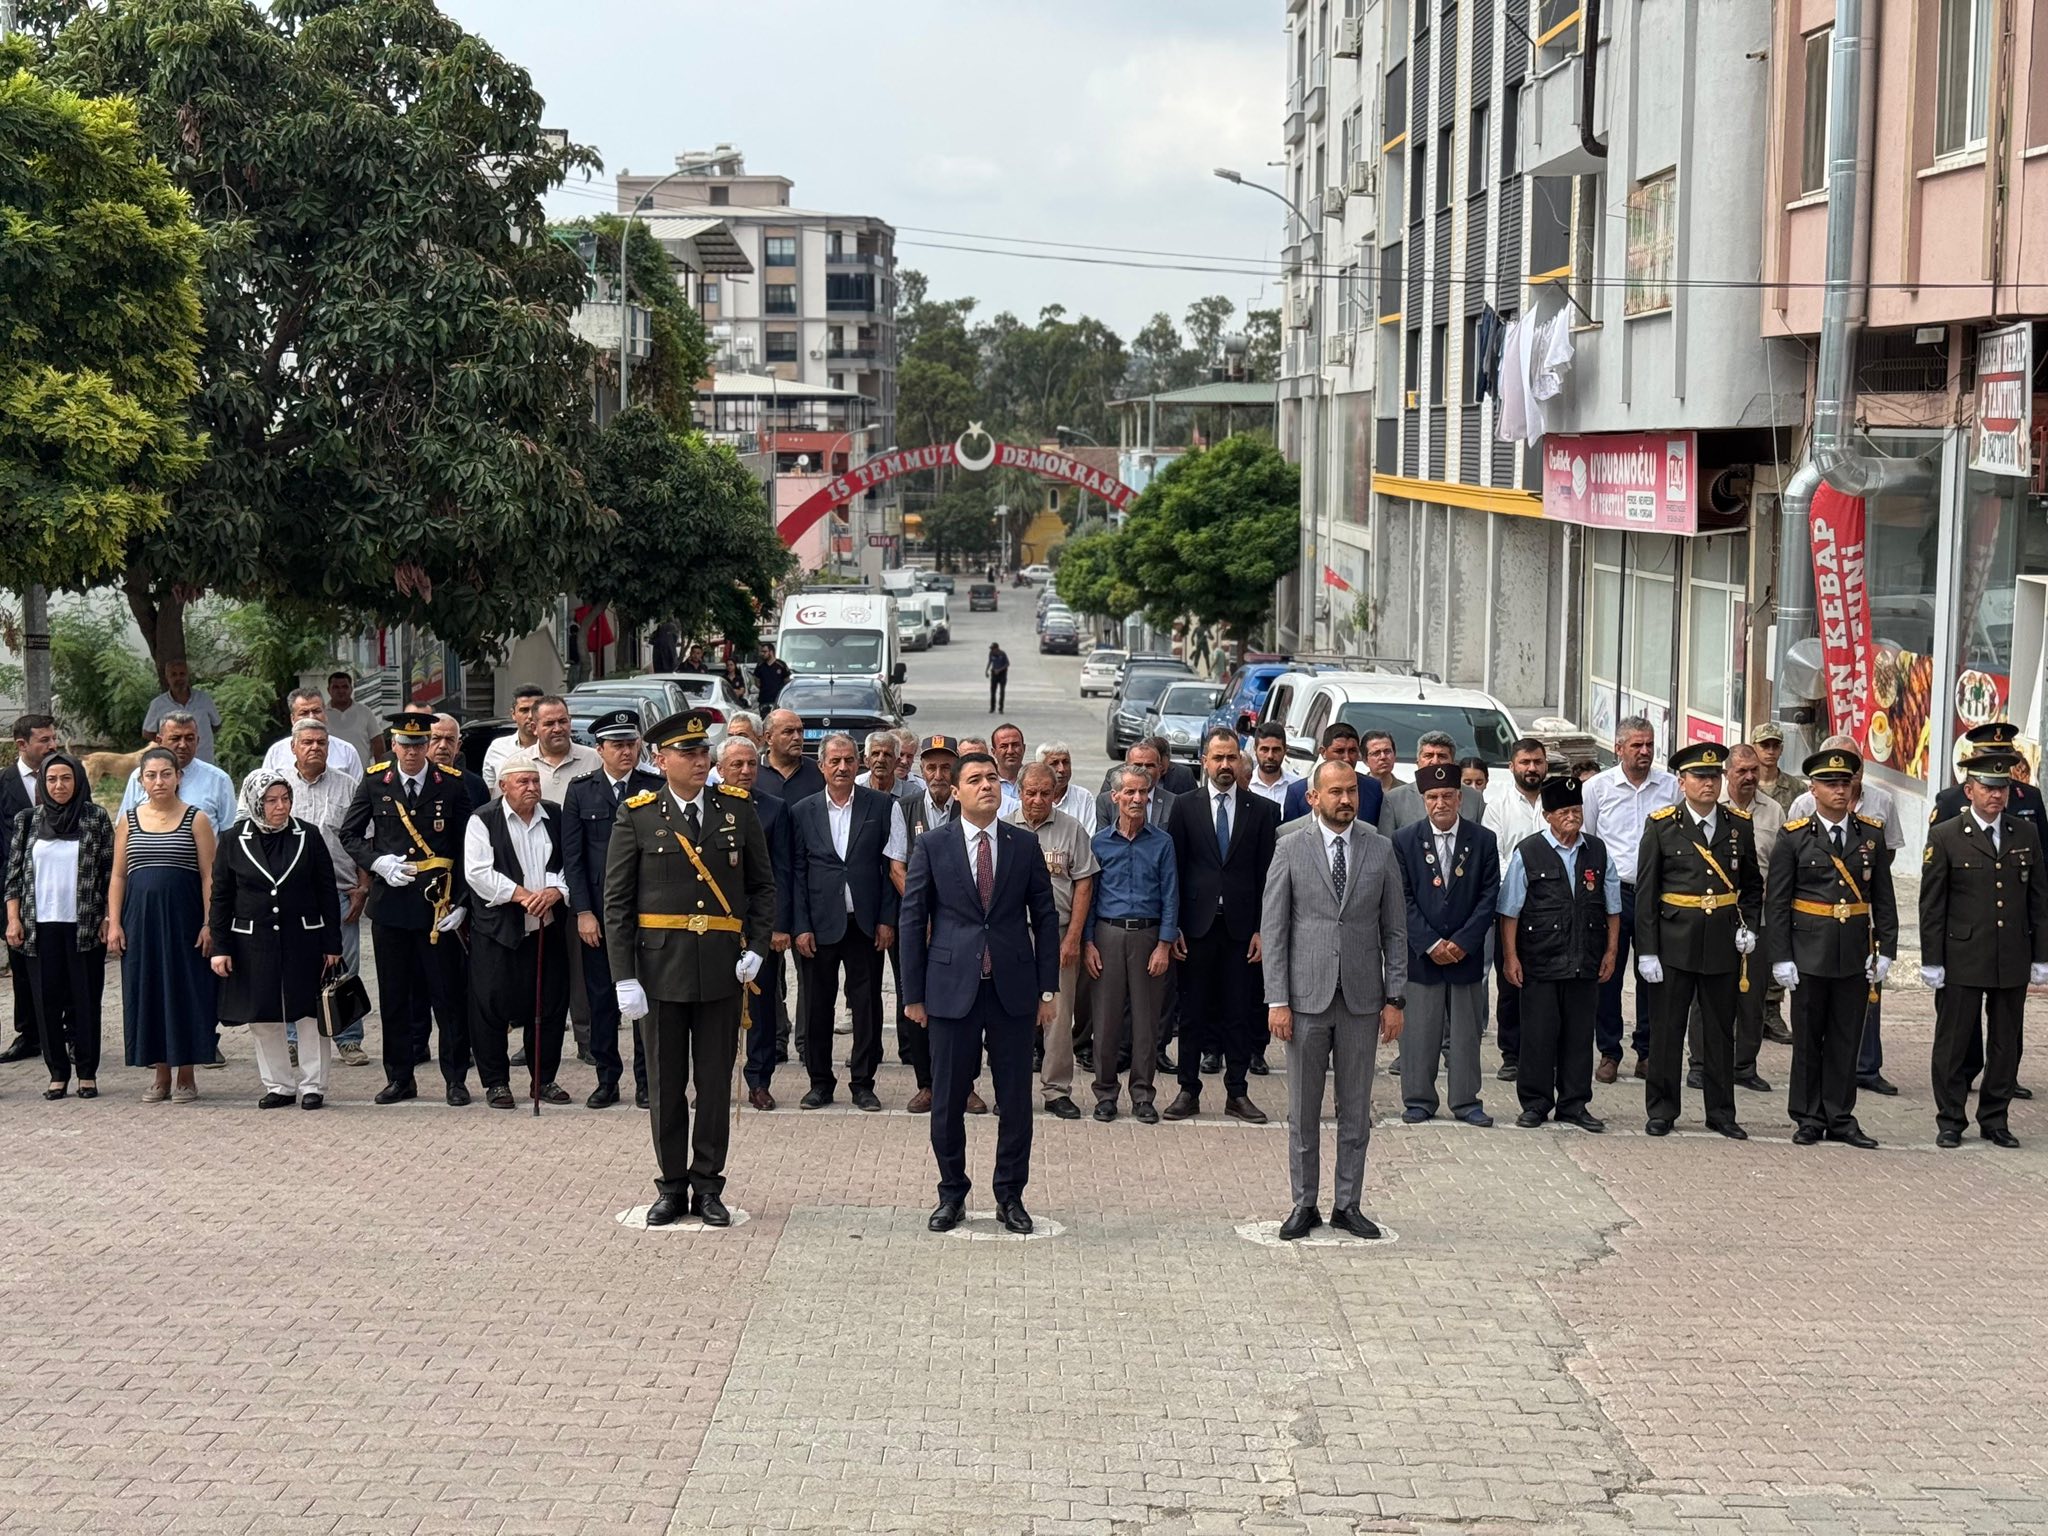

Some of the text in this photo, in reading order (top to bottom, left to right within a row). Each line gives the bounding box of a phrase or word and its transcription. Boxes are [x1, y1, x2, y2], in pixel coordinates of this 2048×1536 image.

[2002, 331, 2026, 373] KEBAP
[826, 483, 851, 501] 15
[855, 446, 953, 487] TEMMUZ
[1813, 517, 1848, 650] KEBAP
[802, 610, 827, 619] 112
